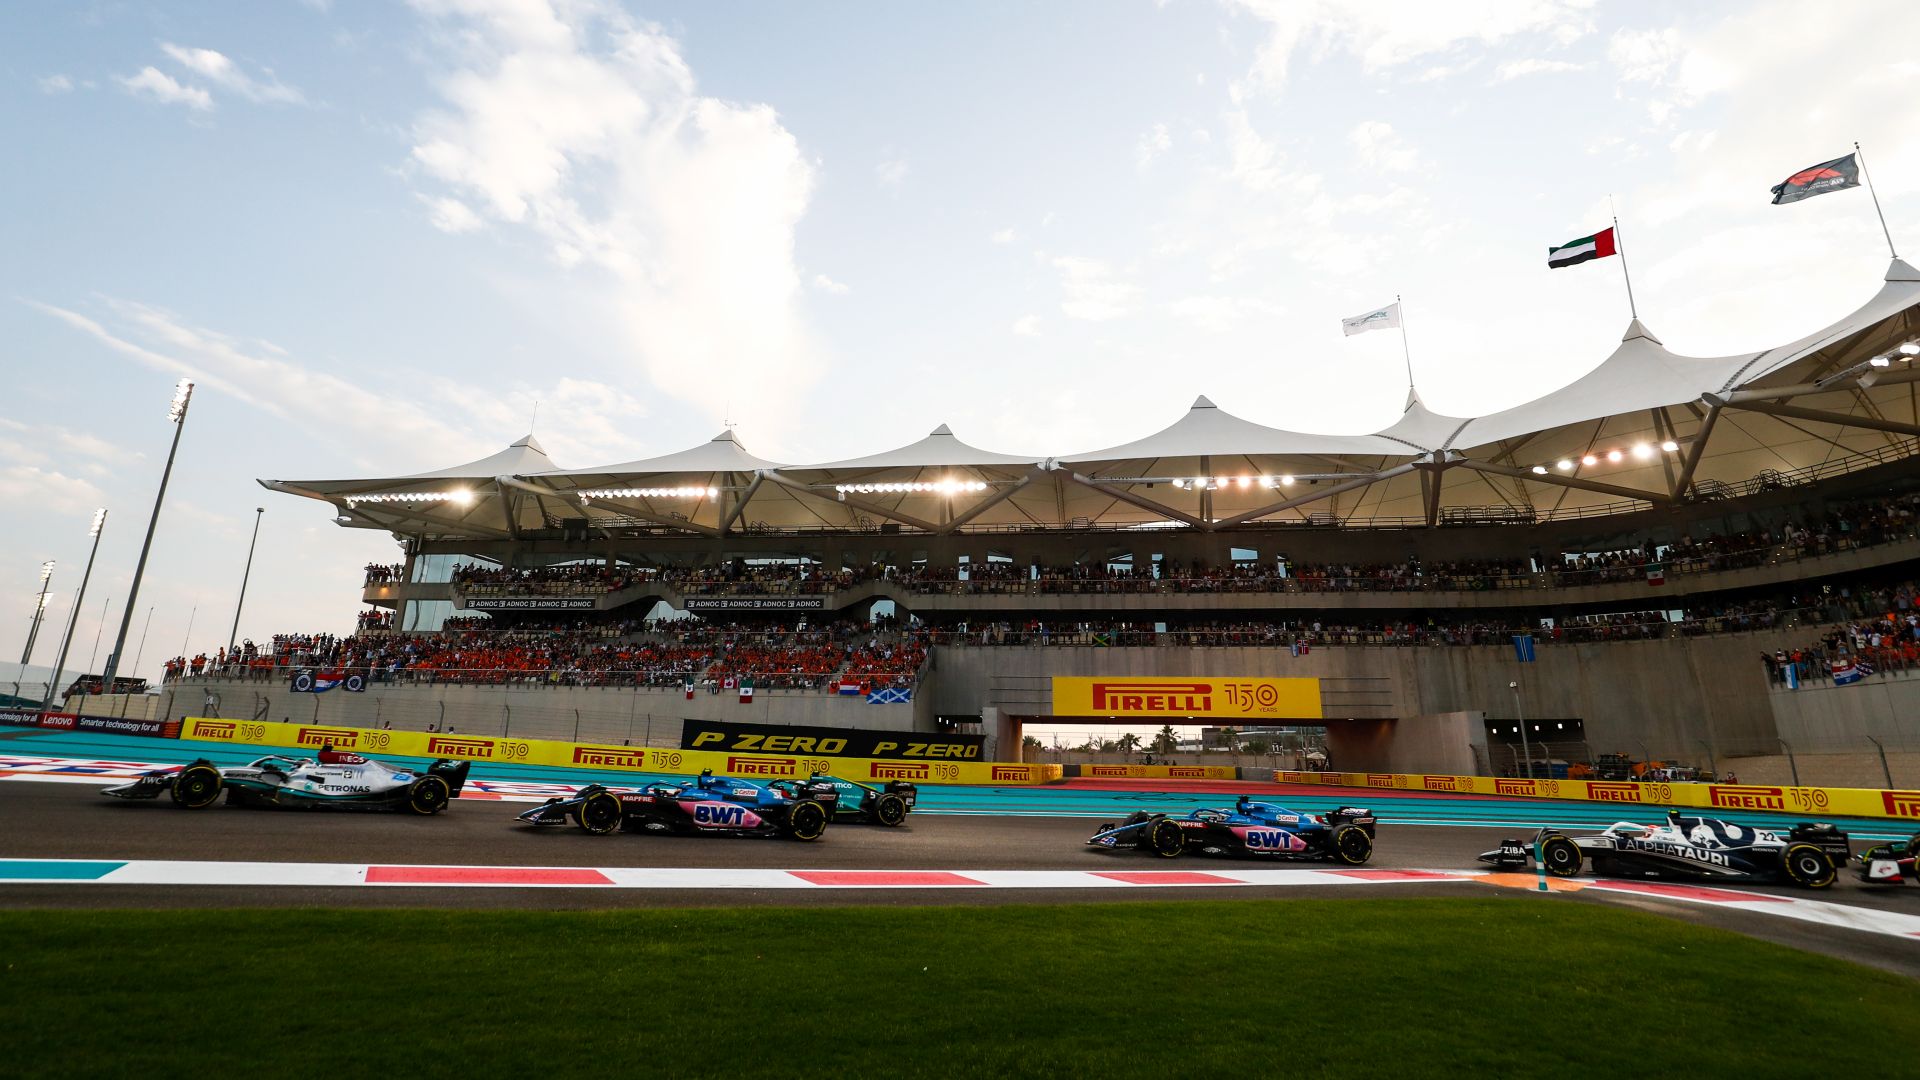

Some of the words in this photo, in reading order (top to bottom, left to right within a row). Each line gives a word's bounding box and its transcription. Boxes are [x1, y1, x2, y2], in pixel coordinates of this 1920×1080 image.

[1092, 683, 1212, 711] PIRELLI
[1224, 684, 1278, 712] 150
[22, 714, 31, 722] for
[43, 714, 73, 726] Lenovo
[80, 718, 104, 727] Smarter
[105, 720, 140, 732] technology
[141, 722, 151, 731] for
[151, 724, 160, 732] all
[193, 721, 236, 739] PIRELLI
[297, 728, 358, 747] PIRELLI
[428, 737, 494, 757] PIRELLI
[691, 731, 726, 747] P
[731, 734, 848, 754] ZERO
[871, 741, 898, 755] P
[902, 743, 979, 758] ZERO
[339, 755, 365, 763] INEOS
[573, 747, 645, 767] PIRELLI
[727, 756, 797, 775] PIRELLI
[870, 762, 929, 779] PIRELLI
[992, 766, 1030, 781] PIRELLI
[1092, 767, 1127, 775] PIRELLI
[1169, 768, 1205, 776] PIRELLI
[142, 776, 162, 785] IWC
[318, 784, 371, 793] PETRONAS
[1367, 774, 1393, 787] PIRELLI
[1424, 776, 1456, 790] PIRELLI
[1495, 779, 1536, 795] PIRELLI
[622, 795, 653, 803] MAPFRE
[870, 791, 876, 799] 5
[1586, 782, 1640, 801] PIRELLI
[1709, 786, 1784, 809] PIRELLI
[695, 805, 746, 826] BWT
[1245, 830, 1293, 849] BWT
[1760, 832, 1776, 842] 22
[1625, 838, 1730, 867] ALPHATAURI
